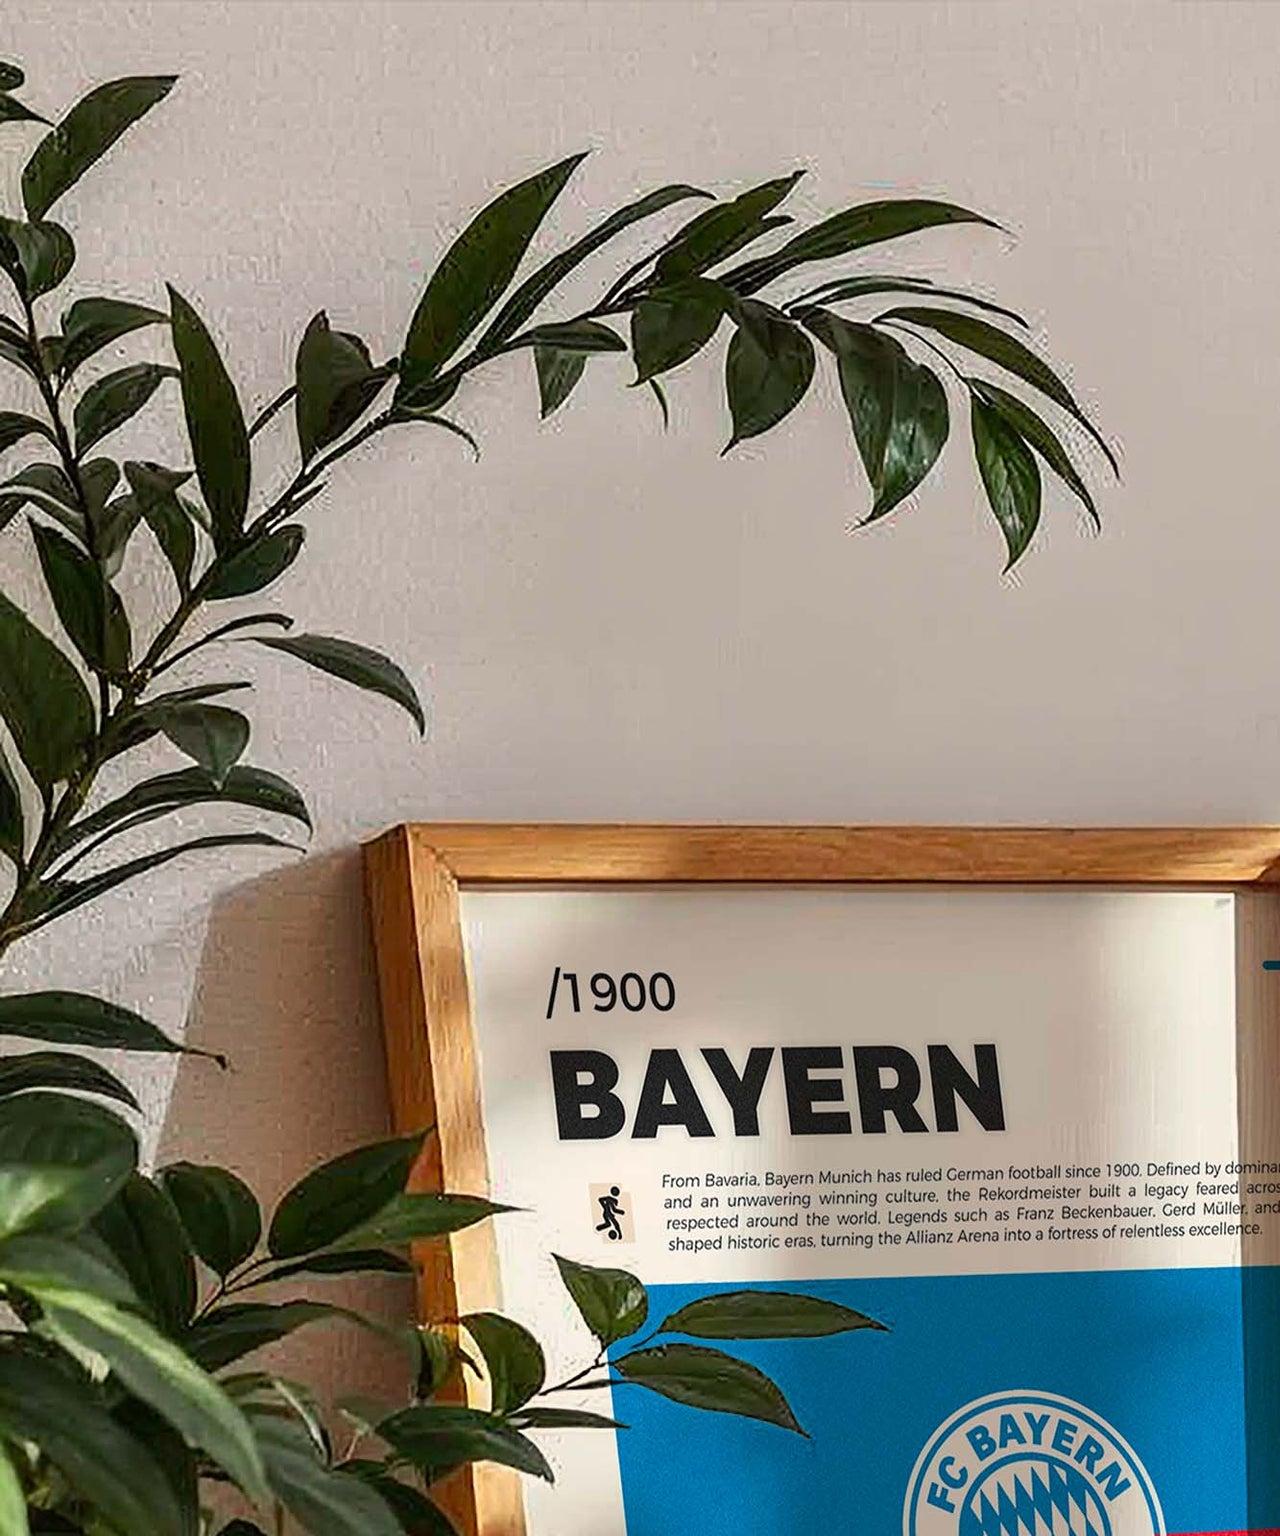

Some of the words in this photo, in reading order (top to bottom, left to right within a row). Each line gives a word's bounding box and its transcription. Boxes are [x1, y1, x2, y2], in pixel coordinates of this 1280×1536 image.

[546, 967, 676, 1019] /1900
[549, 1044, 1006, 1140] BAYERN
[668, 1234, 723, 1254] shaped
[727, 1233, 781, 1250] historic
[820, 1231, 874, 1249] turning
[877, 1230, 903, 1246] the
[905, 1229, 954, 1245] Allianz
[956, 1229, 1000, 1243] Arena
[1003, 1227, 1032, 1242] into
[1034, 1229, 1044, 1241] a
[1047, 1225, 1099, 1241] fortress
[1101, 1223, 1118, 1240] of
[1119, 1222, 1186, 1239] relentless
[1188, 1221, 1263, 1237] excellence.
[927, 1456, 968, 1514] FC
[965, 1411, 1132, 1502] BAYERN
